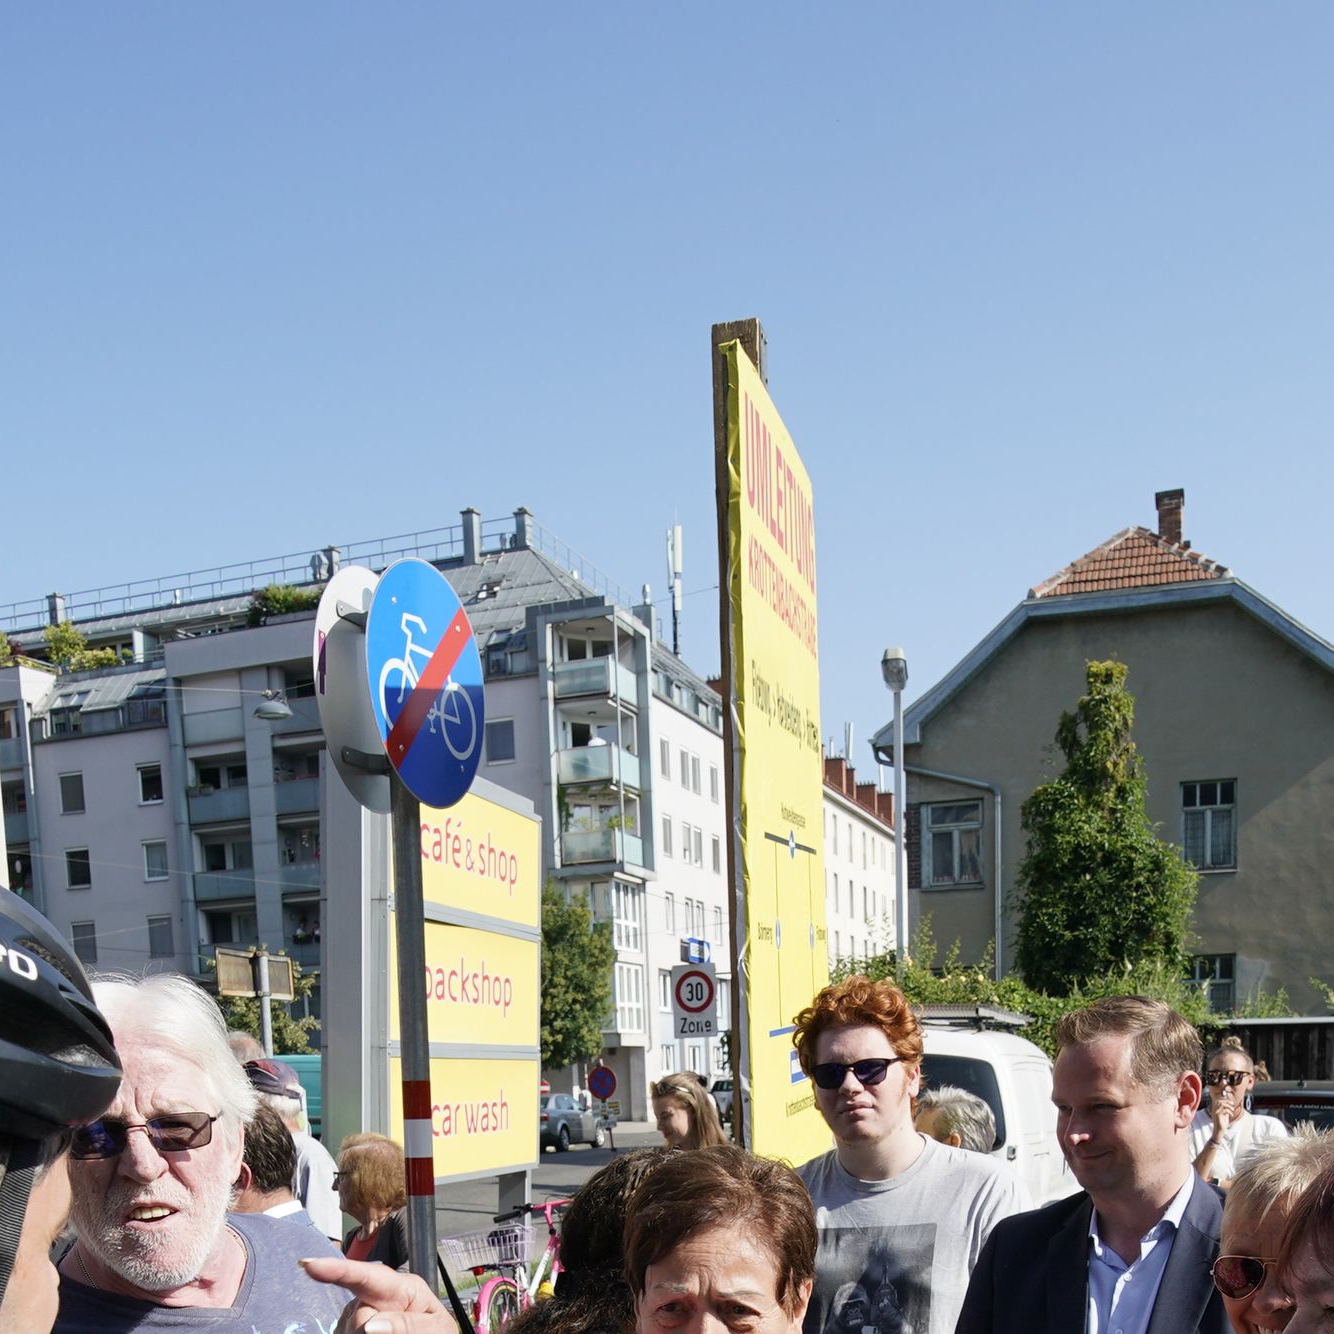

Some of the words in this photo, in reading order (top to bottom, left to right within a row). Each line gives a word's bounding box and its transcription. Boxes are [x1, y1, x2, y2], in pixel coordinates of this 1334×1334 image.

[744, 391, 816, 596] UMLEITUNG
[420, 815, 462, 869] café
[465, 838, 476, 873] &
[478, 832, 518, 897] shop
[686, 982, 704, 1002] 30
[680, 1017, 712, 1034] Zone
[431, 1104, 460, 1138] car
[465, 1088, 509, 1135] wash
